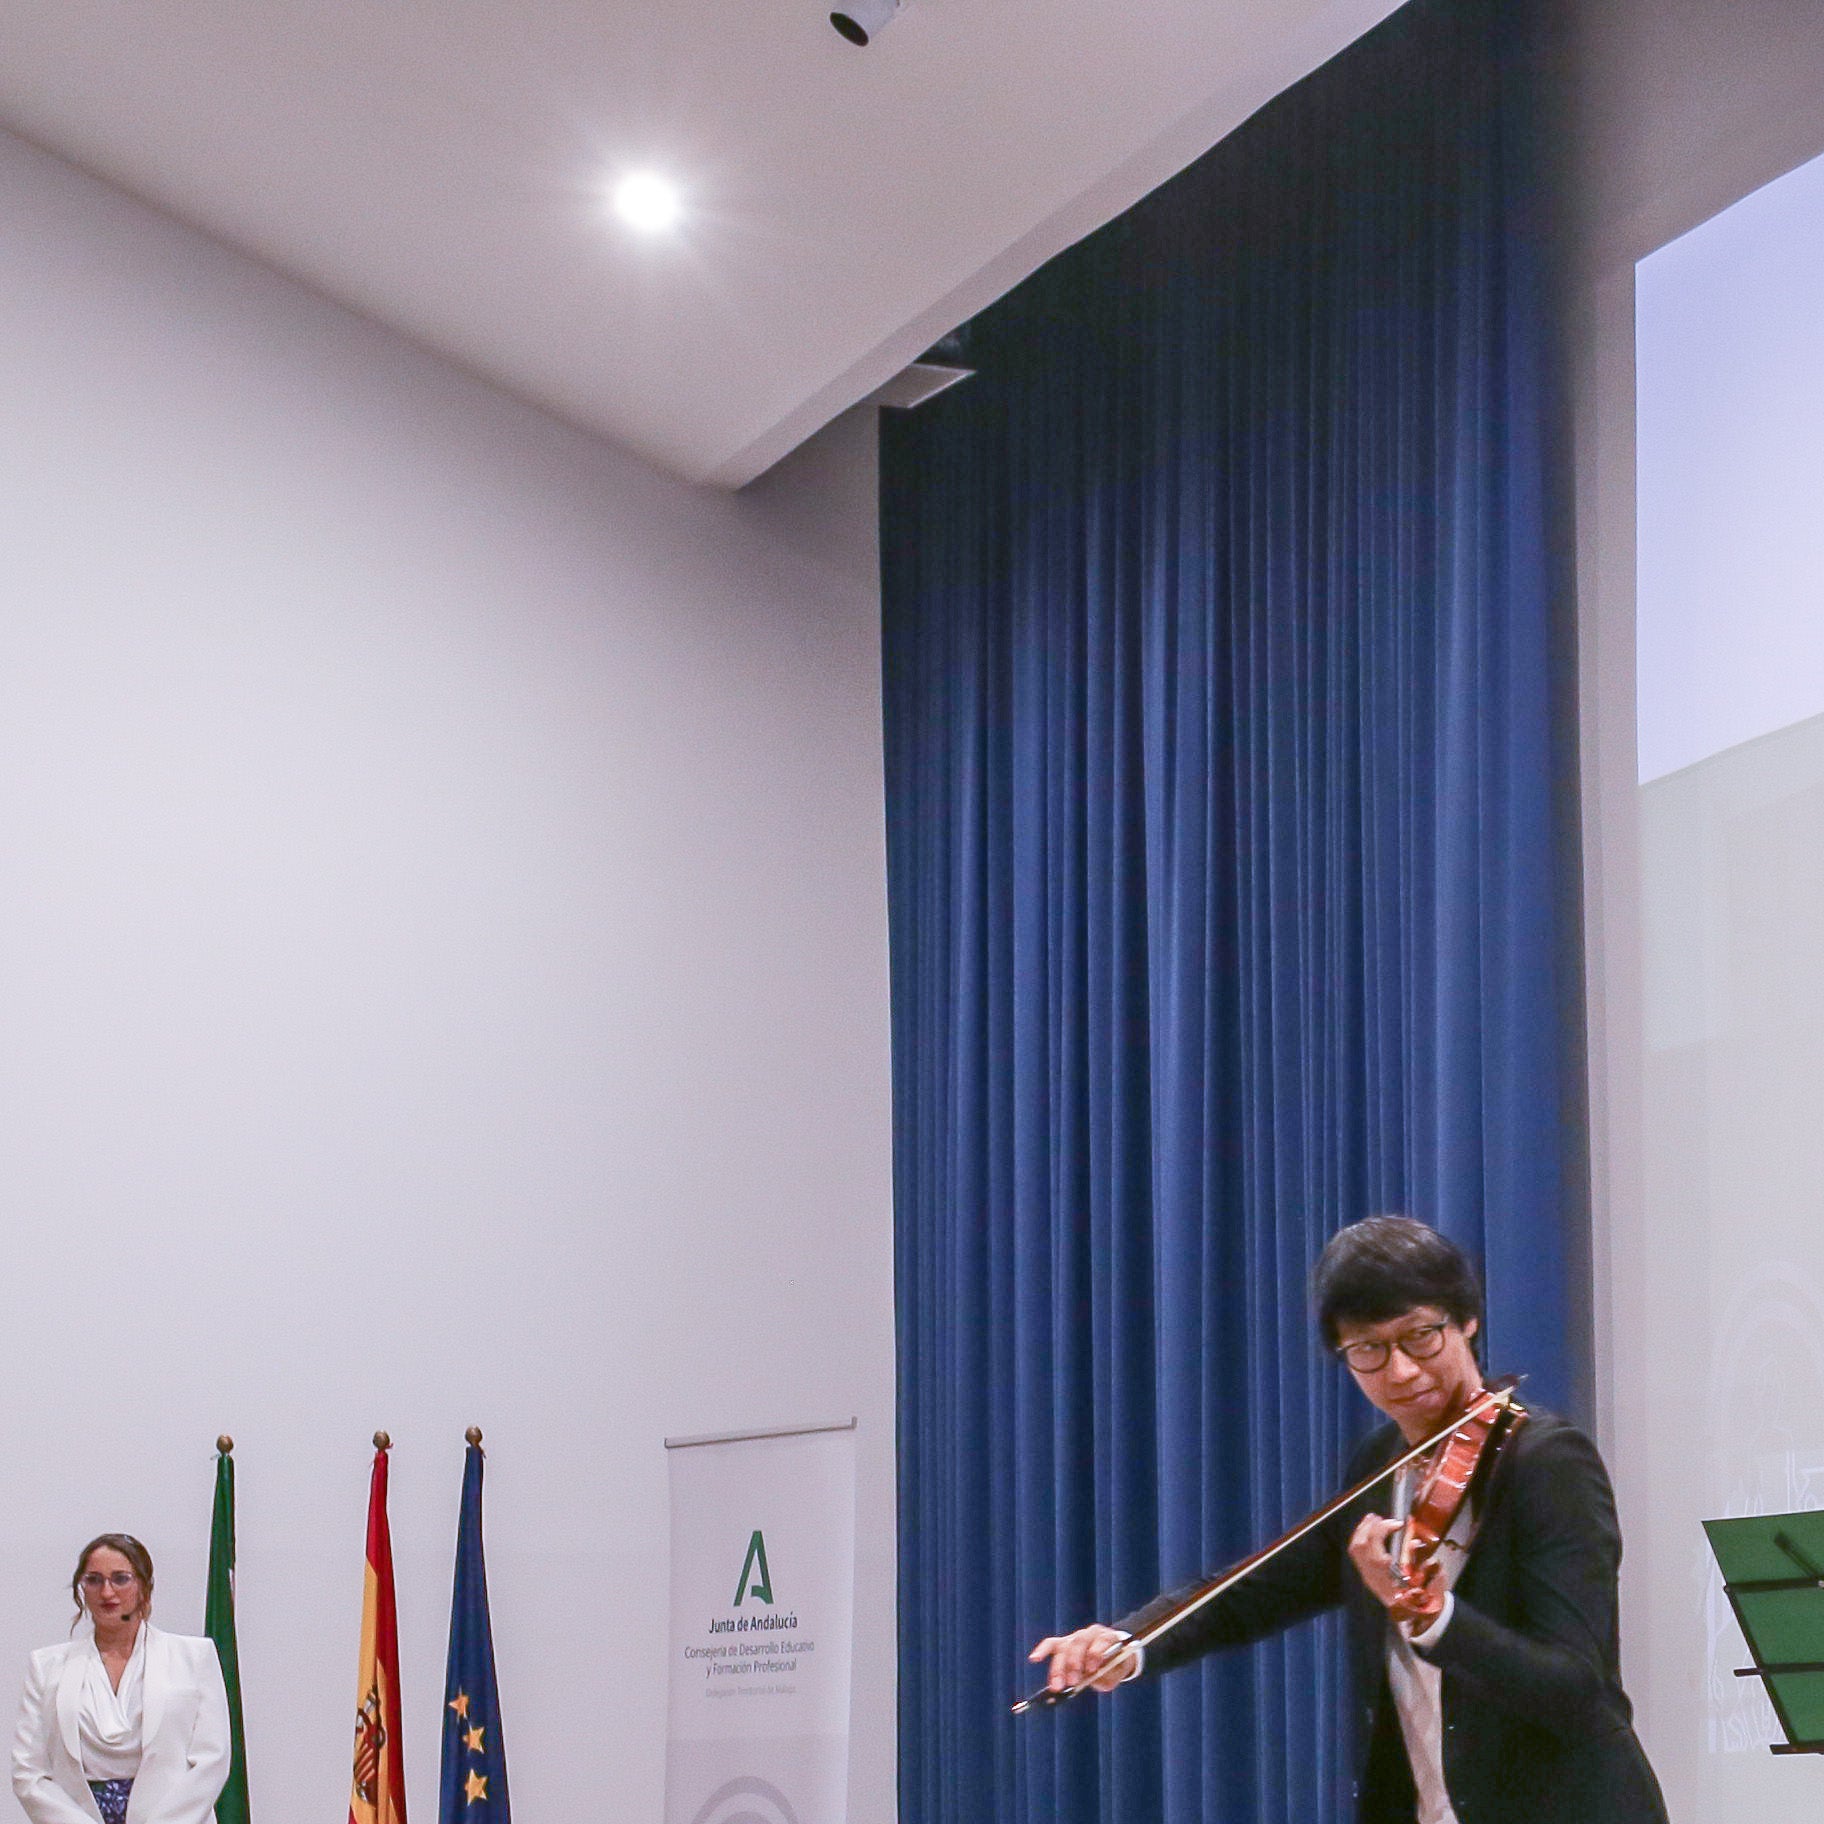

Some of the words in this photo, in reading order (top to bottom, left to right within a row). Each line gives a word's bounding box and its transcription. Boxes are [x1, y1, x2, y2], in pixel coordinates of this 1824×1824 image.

[708, 1618, 735, 1634] Junta
[737, 1616, 749, 1632] de
[750, 1611, 798, 1631] Andalucía
[684, 1644, 726, 1660] Consejería
[728, 1644, 738, 1656] de
[739, 1641, 779, 1656] Desarrollo
[780, 1640, 815, 1655] Educativo
[713, 1660, 752, 1675] Formación
[754, 1658, 797, 1673] Profesional
